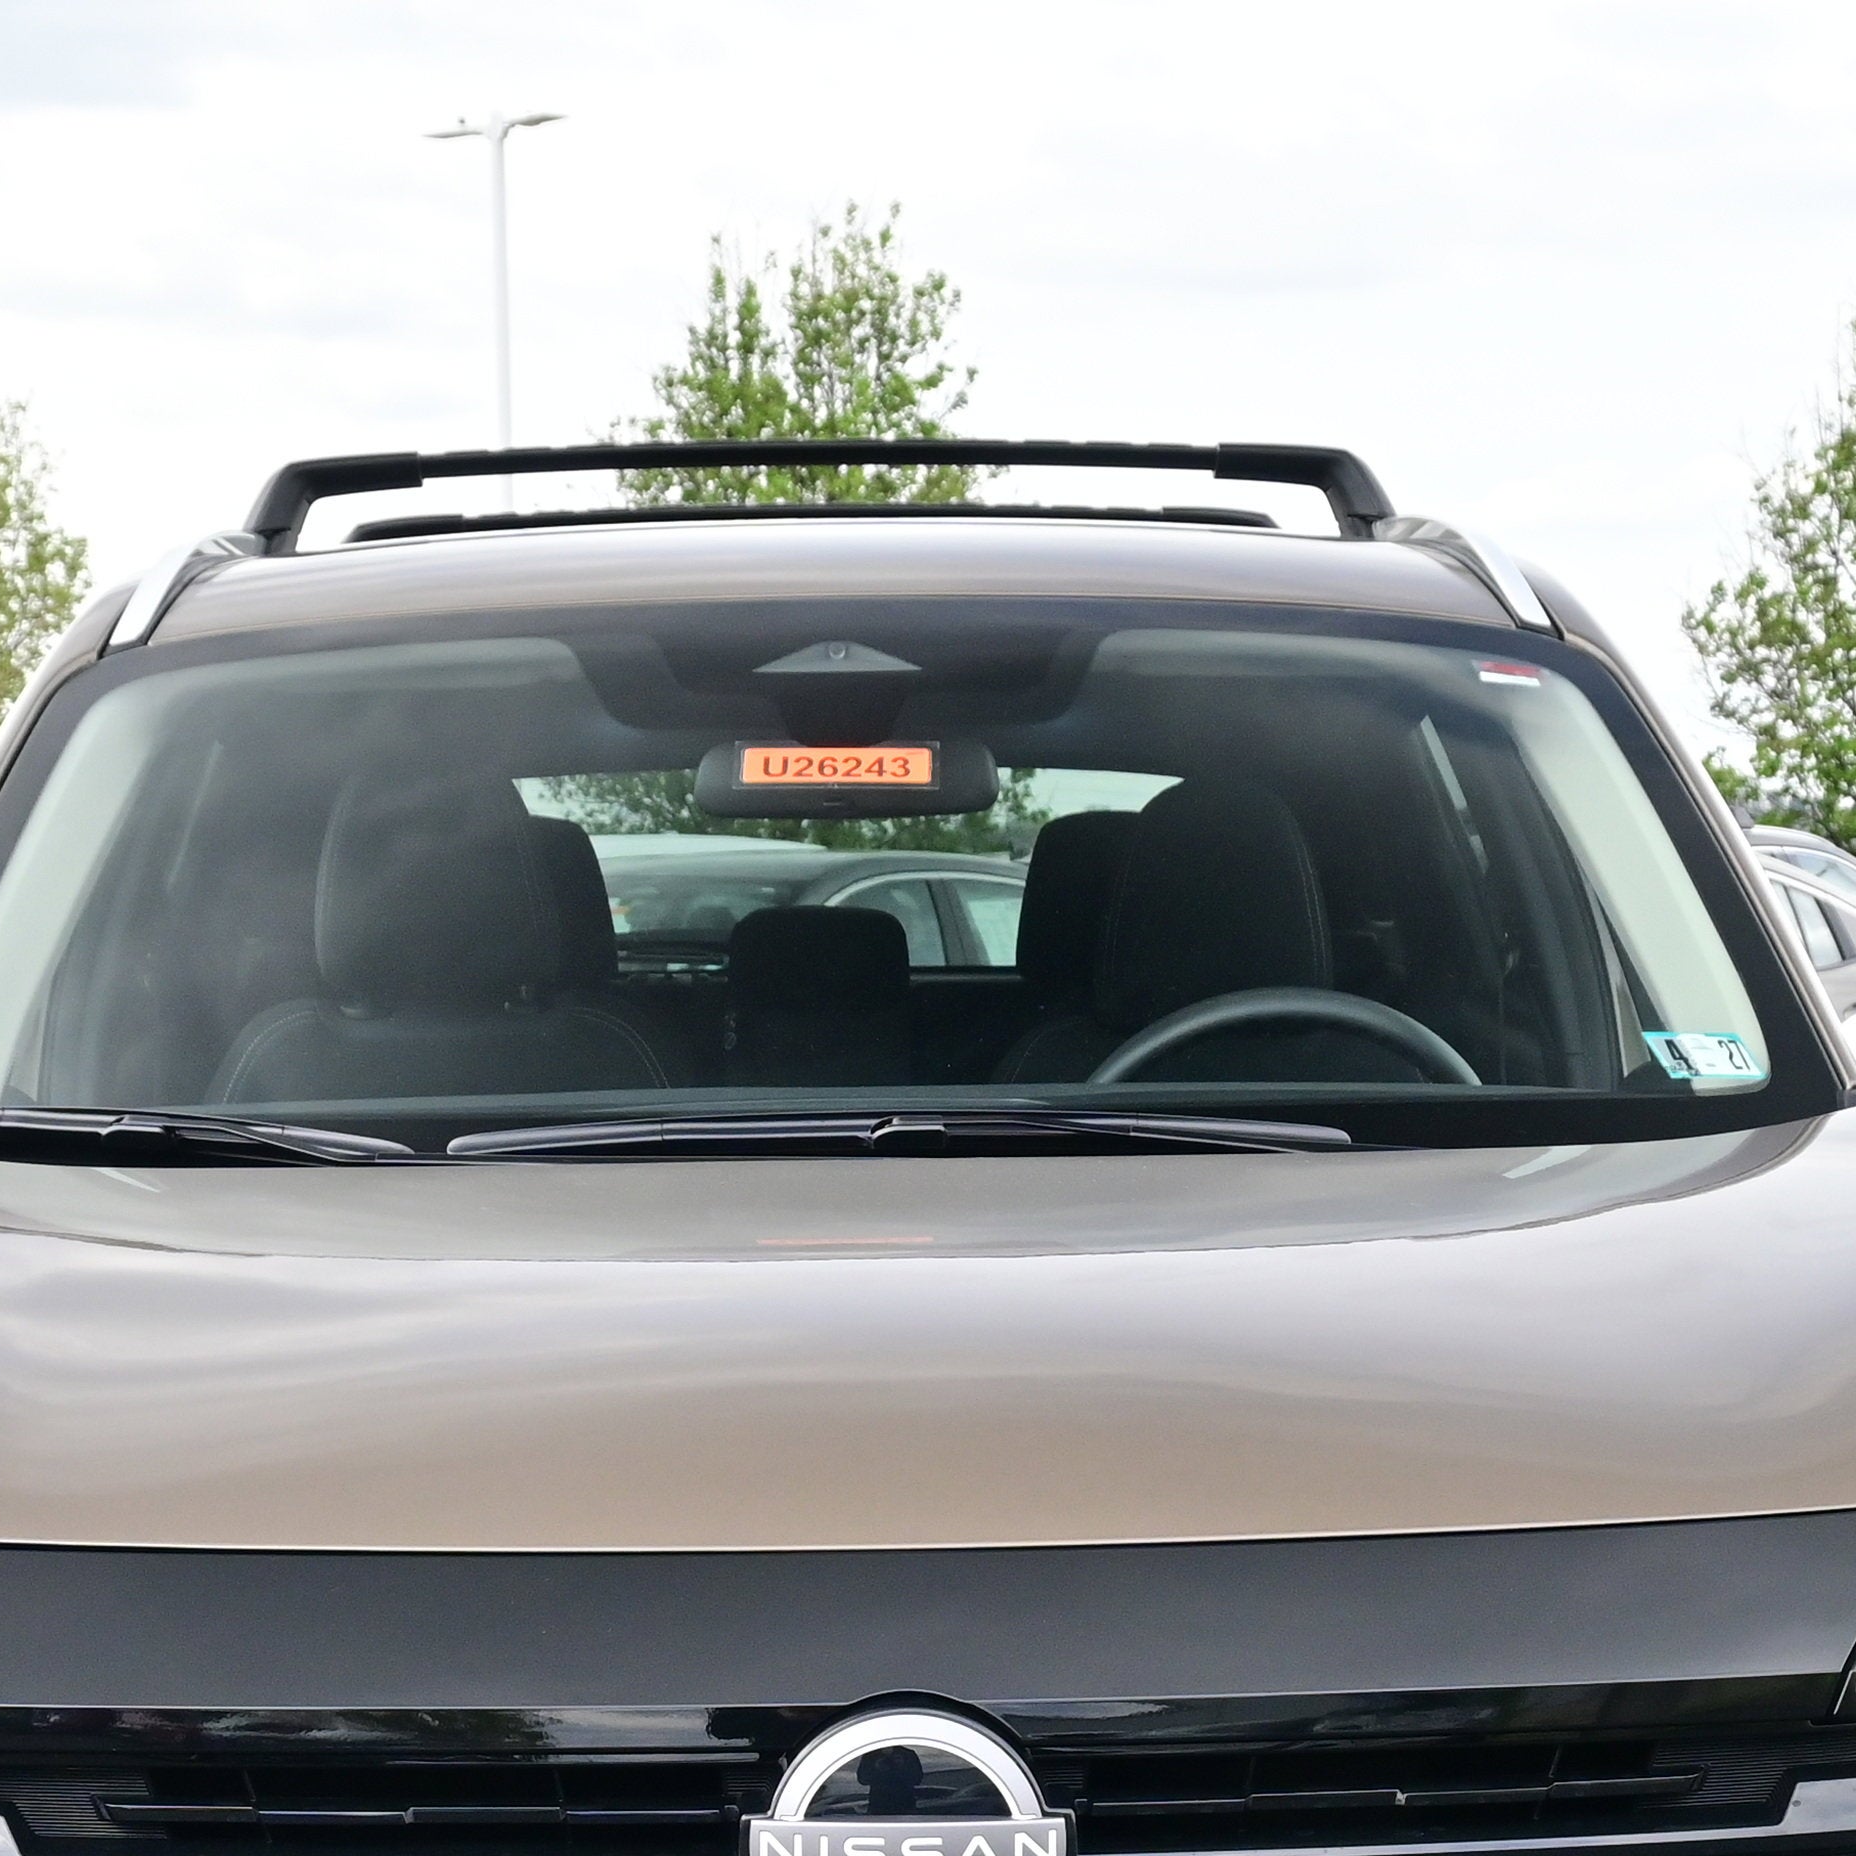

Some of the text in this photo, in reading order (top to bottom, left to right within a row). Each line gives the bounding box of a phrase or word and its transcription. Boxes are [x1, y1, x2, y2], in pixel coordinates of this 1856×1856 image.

[762, 755, 911, 778] U26243
[1664, 1038, 1751, 1072] 4 27
